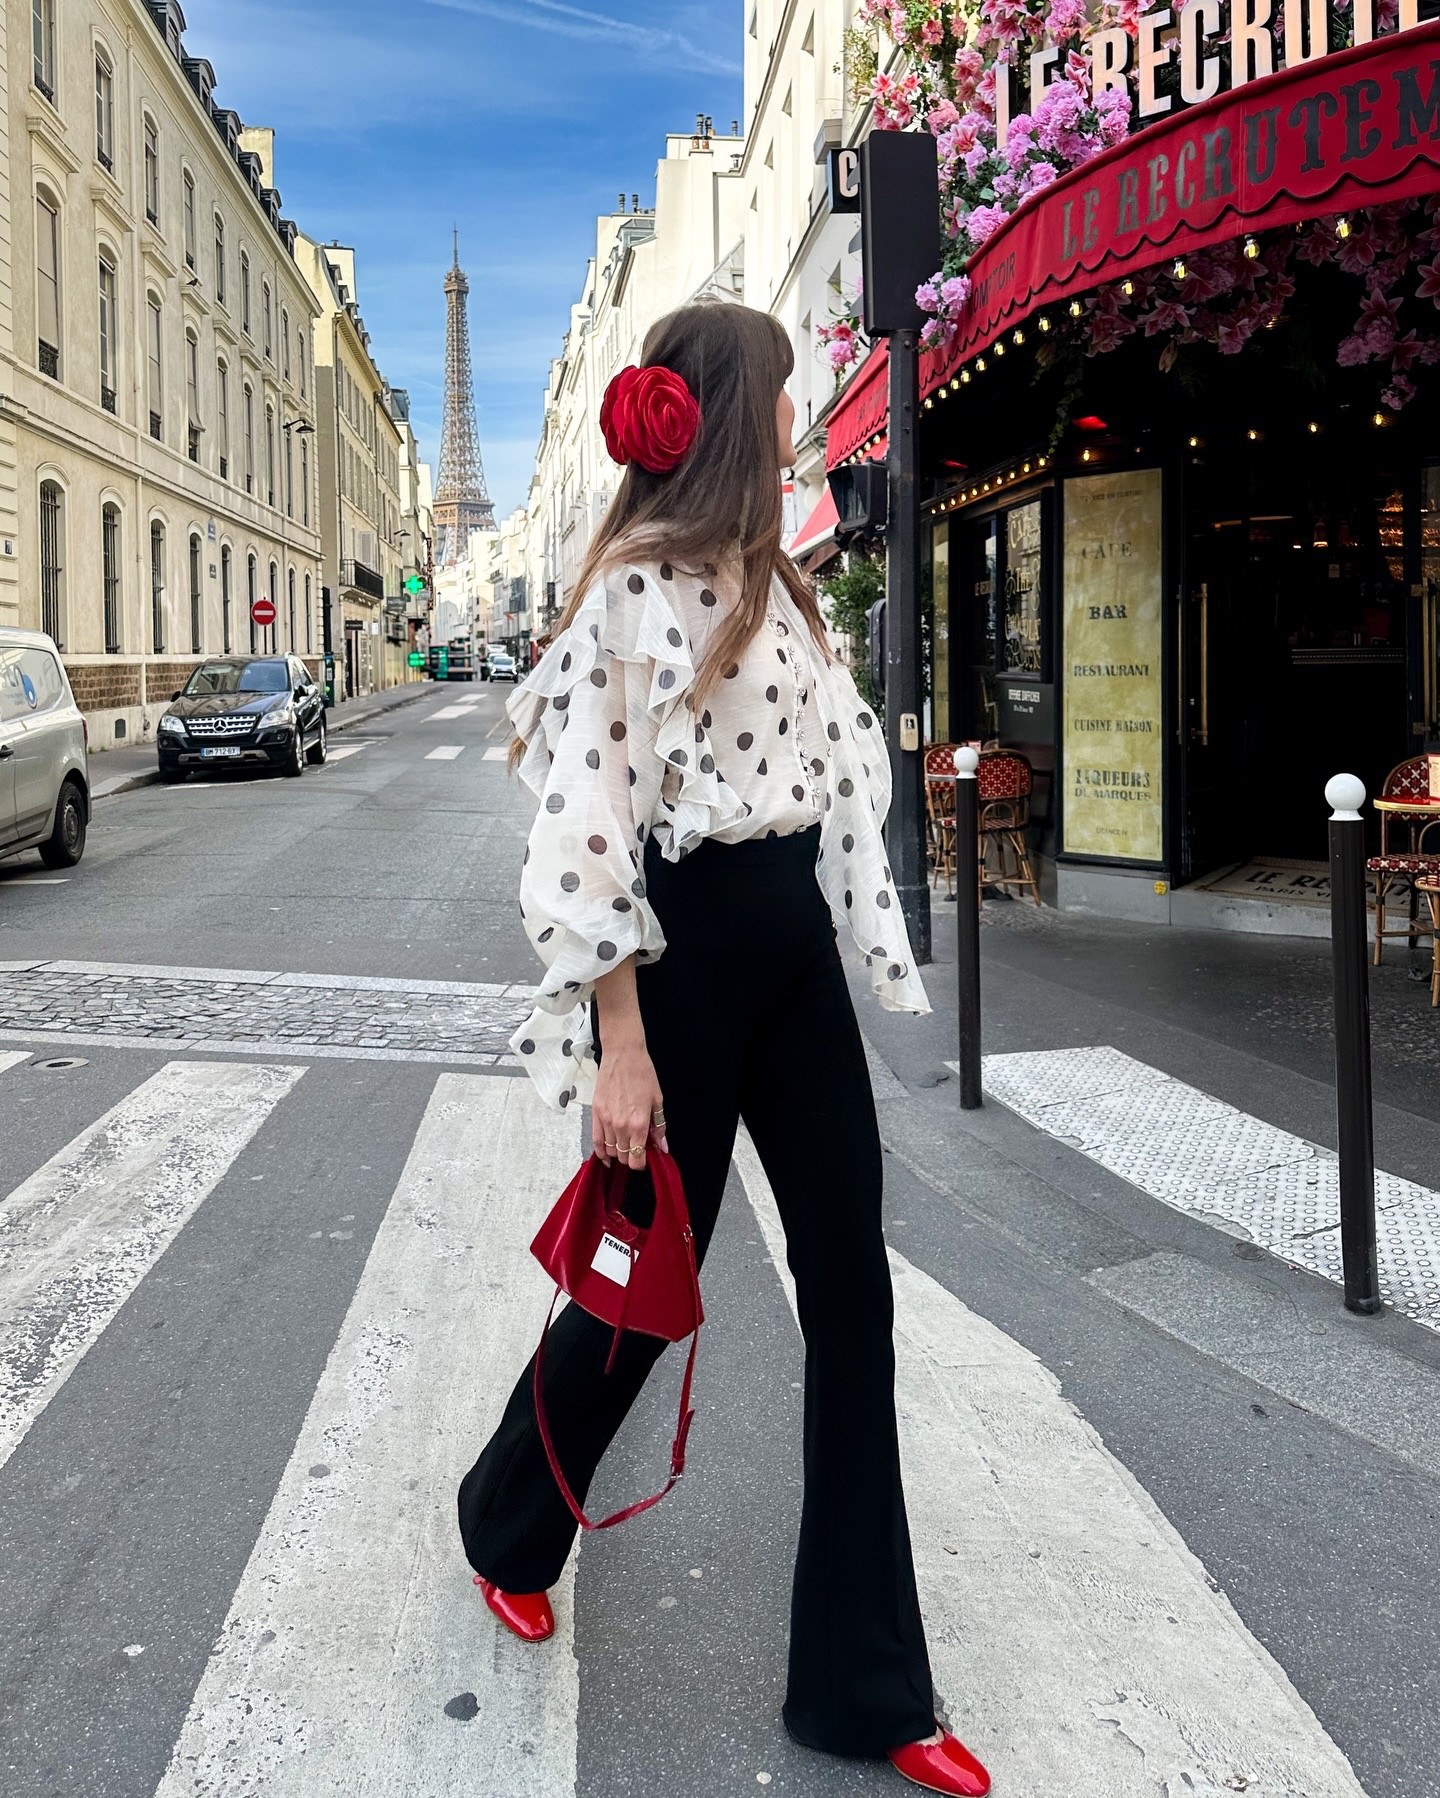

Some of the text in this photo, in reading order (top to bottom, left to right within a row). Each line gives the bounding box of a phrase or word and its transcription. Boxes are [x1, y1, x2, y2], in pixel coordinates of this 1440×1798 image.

[1092, 0, 1440, 118] RECRU
[1059, 60, 1440, 262] LE RECRUTEM
[973, 252, 1017, 314] OMPTOIR
[1089, 604, 1128, 620] BAR
[1073, 664, 1150, 677] RESTAURANT
[1074, 718, 1153, 733] CUISINE MAISON
[1075, 769, 1151, 789] LIQUEURS
[1093, 789, 1152, 802] MARQUES
[1245, 871, 1284, 884] LE
[604, 1236, 631, 1257] TENER
